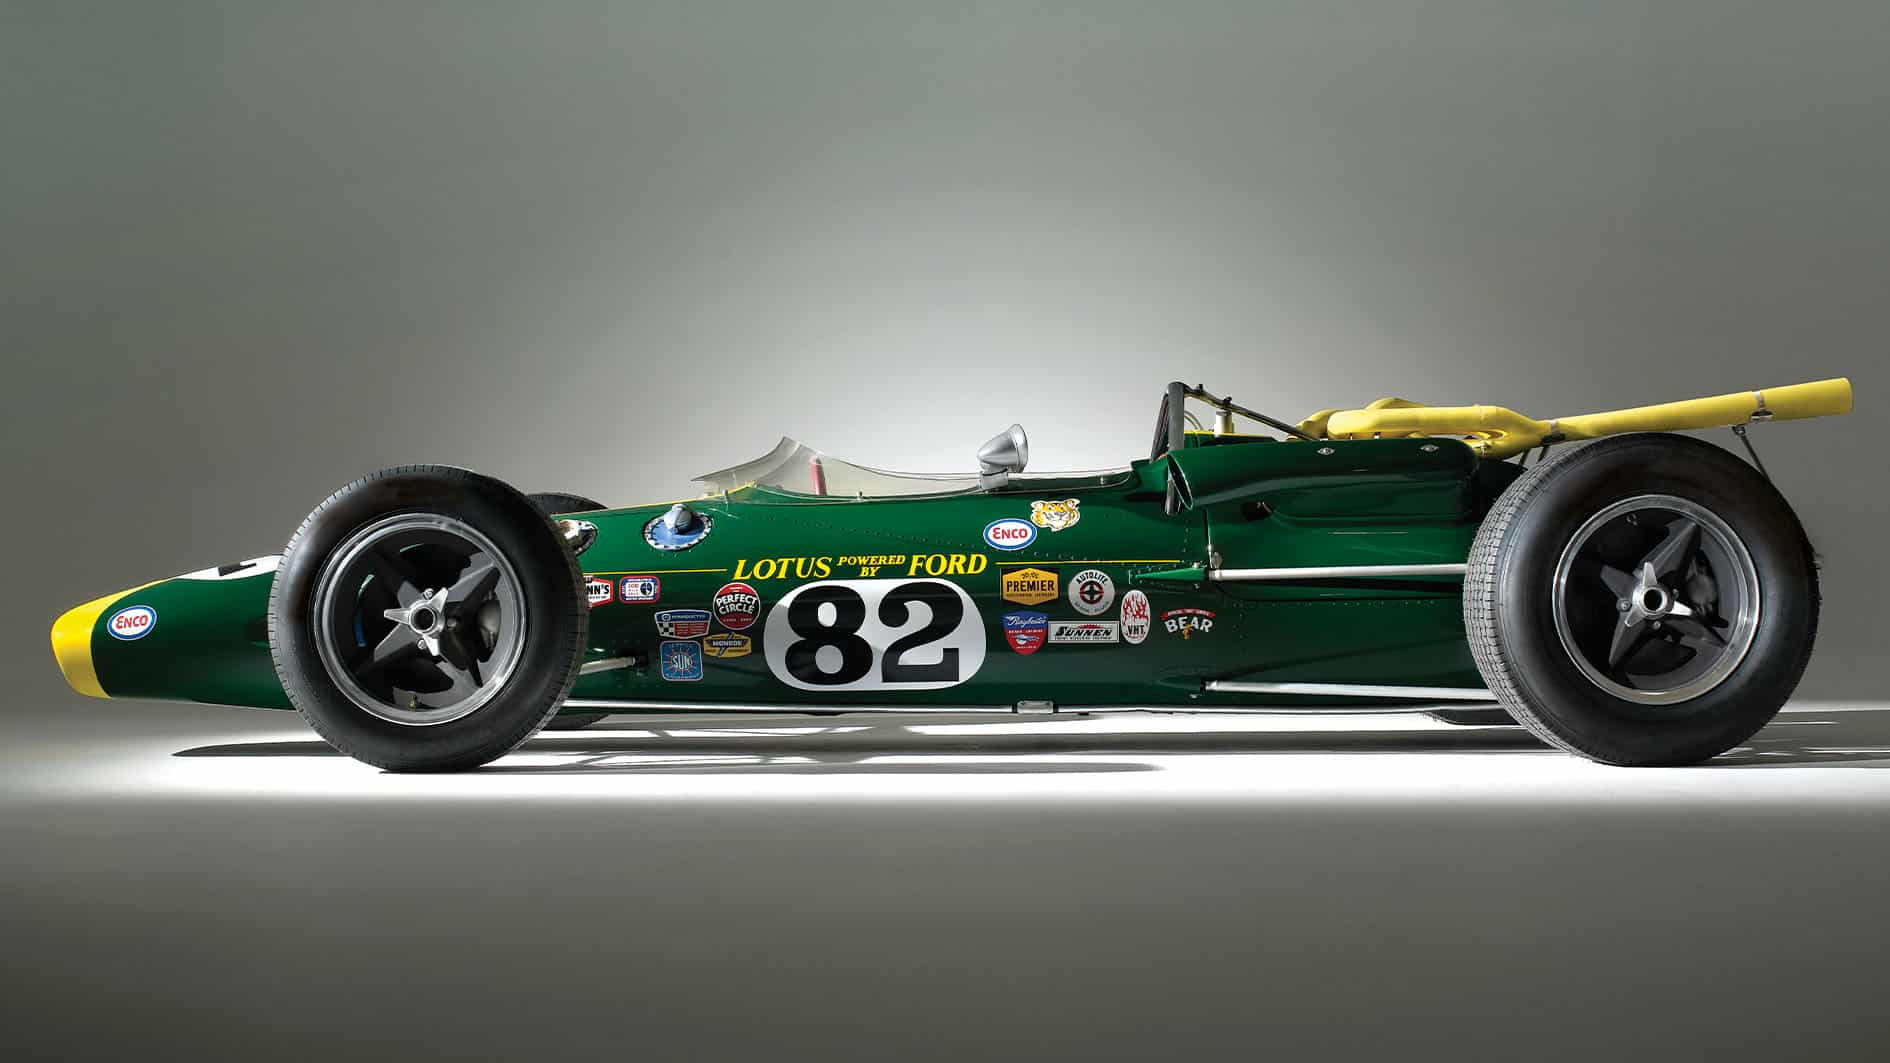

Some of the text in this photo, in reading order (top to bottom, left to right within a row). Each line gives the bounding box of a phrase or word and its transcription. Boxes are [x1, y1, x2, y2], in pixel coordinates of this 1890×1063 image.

[992, 526, 1028, 540] ENCO
[732, 554, 987, 580] LOTUS POWERED BY FORD
[586, 584, 610, 595] NN'S
[1006, 580, 1054, 592] PREMIER
[716, 593, 757, 607] PERFECT
[719, 603, 755, 615] CIRCLE
[115, 615, 148, 630] ENCO
[1164, 616, 1213, 633] BEAR
[785, 582, 964, 685] 82
